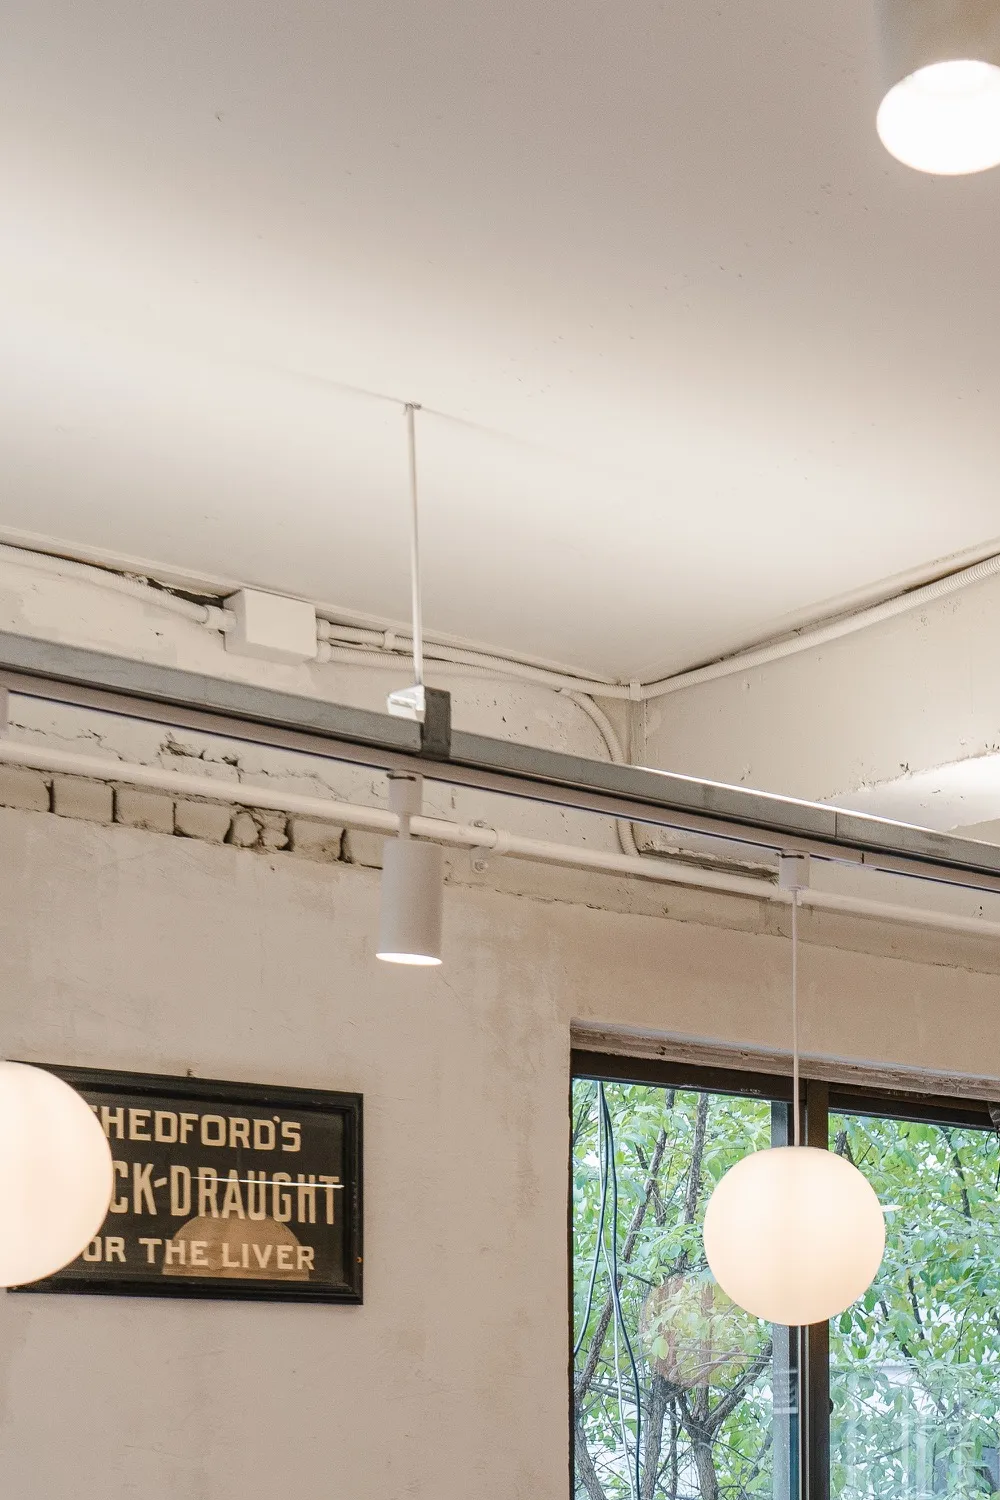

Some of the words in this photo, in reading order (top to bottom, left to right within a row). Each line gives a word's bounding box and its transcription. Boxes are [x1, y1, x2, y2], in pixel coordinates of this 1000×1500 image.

[89, 1105, 300, 1151] HEDFORD'S
[139, 1238, 208, 1266] THE
[222, 1242, 314, 1270] LIVER
